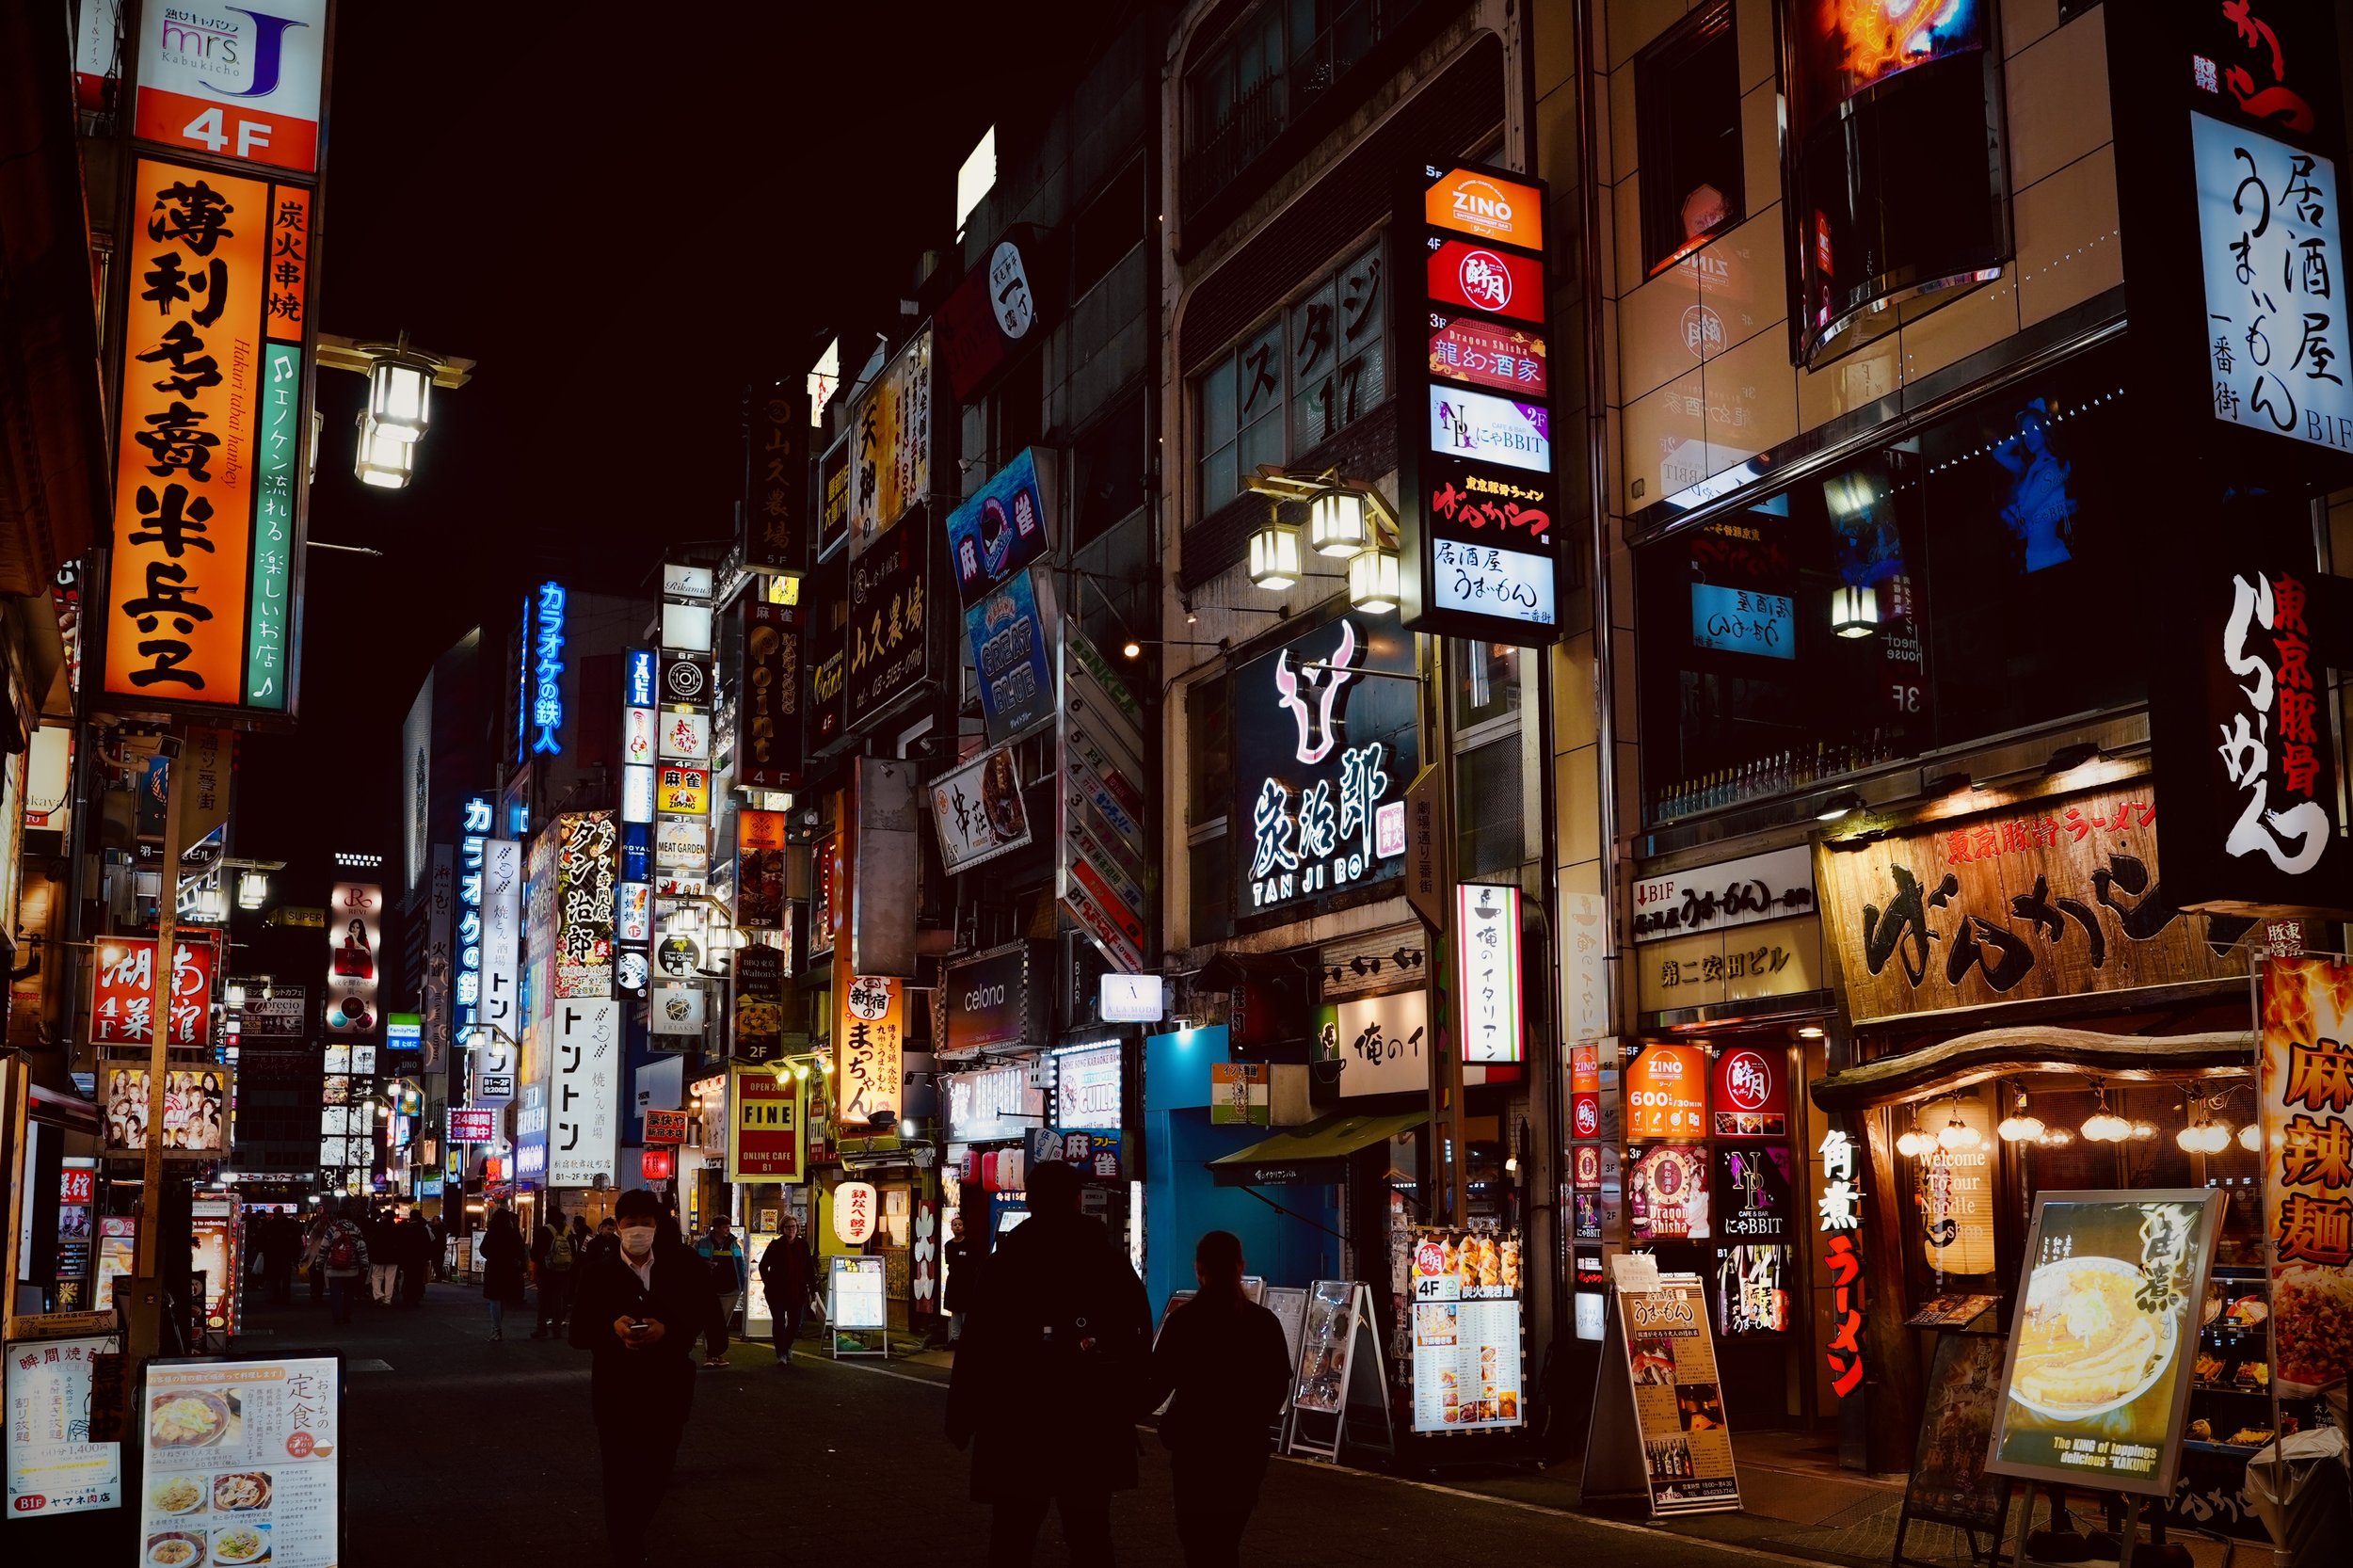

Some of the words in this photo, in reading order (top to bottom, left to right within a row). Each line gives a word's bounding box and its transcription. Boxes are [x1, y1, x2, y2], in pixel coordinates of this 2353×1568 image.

[161, 51, 240, 77] Kabukicho
[183, 107, 272, 158] 4F
[1425, 165, 1443, 179] 5F
[1452, 190, 1513, 221] ZINO
[1427, 237, 1442, 250] 4F
[268, 201, 306, 323] 炭火串焼
[2278, 154, 2344, 387] 居酒屋
[1465, 259, 1506, 305] 酔月
[2229, 146, 2297, 432] うまいもん
[1429, 313, 1447, 328] 3F
[1449, 329, 1487, 347] Dragon
[1492, 339, 1529, 356] Shisha
[231, 337, 251, 391] Hakuri
[1434, 339, 1542, 382] 龍幻酒家
[2209, 313, 2240, 421] 一番街
[1319, 355, 1363, 442] 17
[228, 389, 248, 433] tabai
[1526, 407, 1547, 427] 2F
[2305, 408, 2353, 450] B1F
[219, 433, 247, 490] hanbey
[1465, 474, 1545, 503] 東京豚骨ラーメン
[1435, 542, 1503, 573] 居酒屋
[756, 605, 793, 622] 麻雀
[1520, 610, 1551, 625] 一番街
[981, 615, 1032, 677] GREAT
[678, 652, 695, 661] 6F
[532, 581, 567, 757] カラオケの鉄人
[632, 653, 651, 705] JAビル
[990, 661, 1036, 715] BLUE
[2272, 570, 2320, 798] 東京豚骨
[749, 625, 780, 763] Point
[1070, 698, 1083, 712] 6
[1070, 730, 1084, 743] 5
[753, 770, 792, 786] 4F
[1069, 763, 1083, 775] 4
[664, 771, 702, 789] 麻雀
[1070, 793, 1083, 807] 3
[1248, 742, 1388, 883] 炭治郎
[1068, 825, 1083, 839] 2
[1945, 800, 2156, 866] 東京豚骨ラーメン
[658, 841, 678, 853] MEAT
[678, 842, 706, 855] GARDEN
[658, 853, 705, 861] ミートガーデン
[1417, 801, 1433, 894] 劇場通り一番街
[595, 819, 614, 923] 牛タン専門店
[1253, 873, 1293, 907] TAN
[1303, 864, 1324, 893] JI
[1335, 853, 1364, 885] RO
[566, 821, 597, 963] タン治郎
[1648, 882, 1674, 903] B1F
[629, 927, 641, 936] 1F
[749, 918, 772, 926] 3F
[676, 953, 694, 962] Olive
[743, 959, 760, 968] BBQ
[1661, 946, 1791, 988] 第二安田ビル
[742, 968, 776, 978] Walton's
[964, 984, 1005, 1013] celona
[1475, 925, 1498, 1060] 俺のイタリアン
[851, 986, 888, 1019] 新宿の
[1129, 1005, 1159, 1014] MODE
[749, 1046, 767, 1058] 2F
[1353, 1021, 1425, 1066] 俺のイ
[1626, 1047, 1639, 1055] 5F
[1087, 1054, 1110, 1067] KARAOKE
[1711, 1049, 1721, 1059] 4F
[847, 1021, 875, 1117] まっちゃん
[1574, 1061, 1597, 1071] ZINO
[1603, 1061, 1613, 1070] 5F
[1648, 1060, 1683, 1074] ZINO
[559, 1006, 582, 1151] トントン
[749, 1081, 771, 1092] OPEN
[1732, 1060, 1766, 1100] 酔月
[592, 1071, 606, 1140] 焼とん酒場
[1079, 1082, 1115, 1114] GUILD
[1630, 1091, 1669, 1107] 600
[454, 1113, 490, 1126] 24時間
[648, 1113, 685, 1126] 豪快や
[744, 1105, 792, 1124] FINE
[1604, 1109, 1614, 1118] 4F
[454, 1127, 489, 1139] 営業中
[648, 1128, 683, 1138] 新宿本店
[1092, 1137, 1118, 1147] フリー
[743, 1151, 772, 1160] ONLINE
[772, 1151, 792, 1160] CAFE
[1629, 1147, 1642, 1160] 3F
[1919, 1149, 1986, 1168] Welcome
[2277, 1037, 2353, 1268] 麻辣麺
[762, 1163, 772, 1172] B1
[1605, 1163, 1615, 1173] 3F
[1927, 1175, 1948, 1191] To
[1953, 1176, 1980, 1191] our
[850, 1189, 867, 1238] 鉄なべ餃子
[1649, 1205, 1689, 1220] Dragon
[1920, 1196, 1976, 1215] Noodle
[1607, 1210, 1617, 1221] 2F
[1651, 1220, 1688, 1234] Shisha
[1717, 1248, 1728, 1258] B1
[1817, 1129, 1865, 1400] 角煮ラーメン
[1418, 1280, 1440, 1297] 4F
[286, 1373, 316, 1431] 定食
[316, 1379, 329, 1430] おうちの
[2053, 1436, 2072, 1450] The
[2073, 1438, 2097, 1453] KING
[2097, 1440, 2109, 1454] of
[2110, 1443, 2157, 1460] toppings
[2060, 1450, 2106, 1466] delicious
[20, 1497, 42, 1510] B1F
[51, 1492, 111, 1507] ヤマネ肉店
